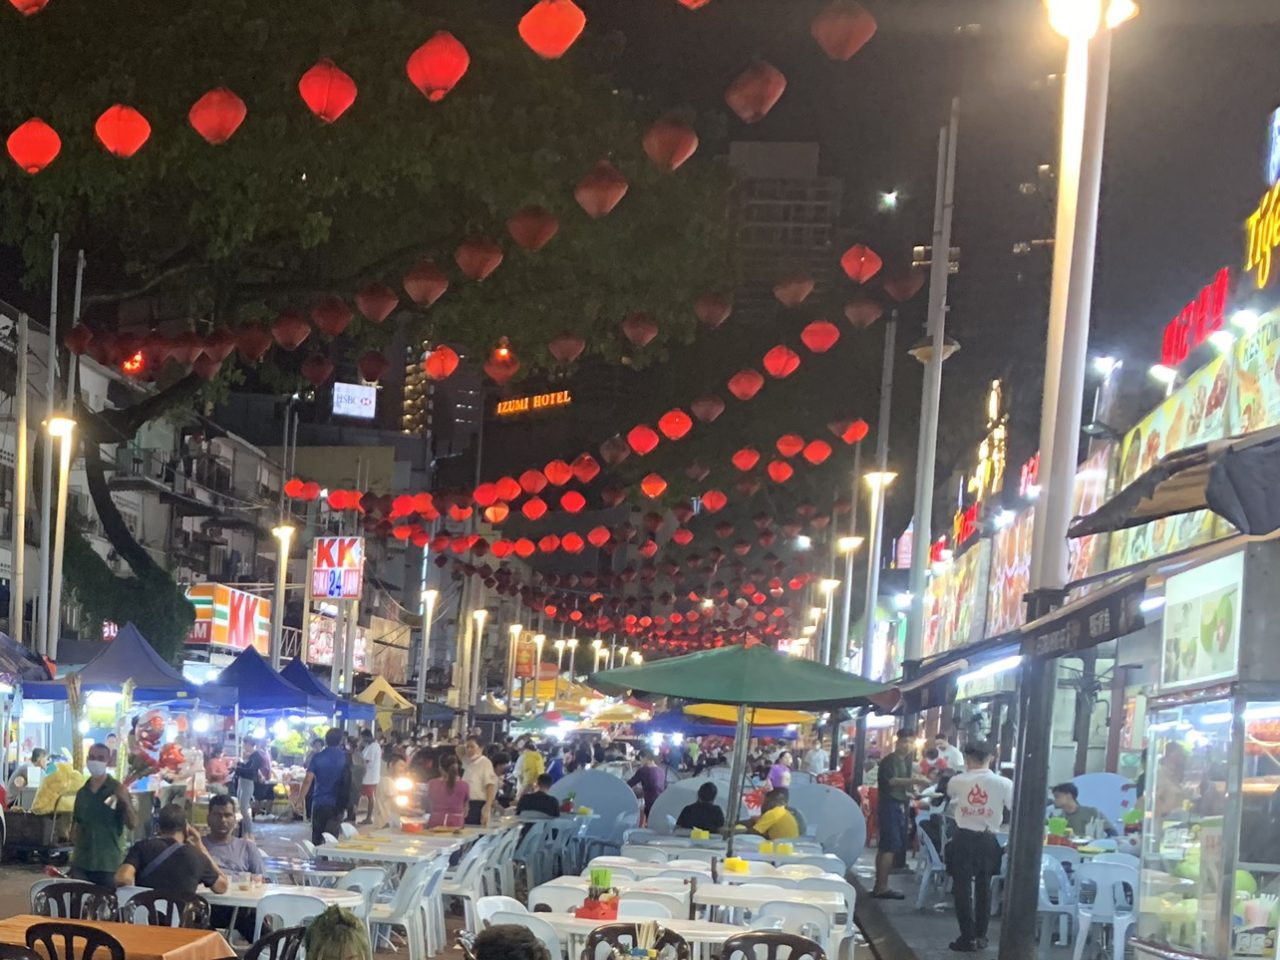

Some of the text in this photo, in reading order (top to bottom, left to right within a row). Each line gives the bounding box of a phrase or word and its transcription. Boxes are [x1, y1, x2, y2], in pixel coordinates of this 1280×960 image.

[497, 390, 571, 414] IZUMI HOTEL
[317, 538, 358, 568] KK
[329, 570, 342, 596] 24
[227, 590, 258, 649] KK
